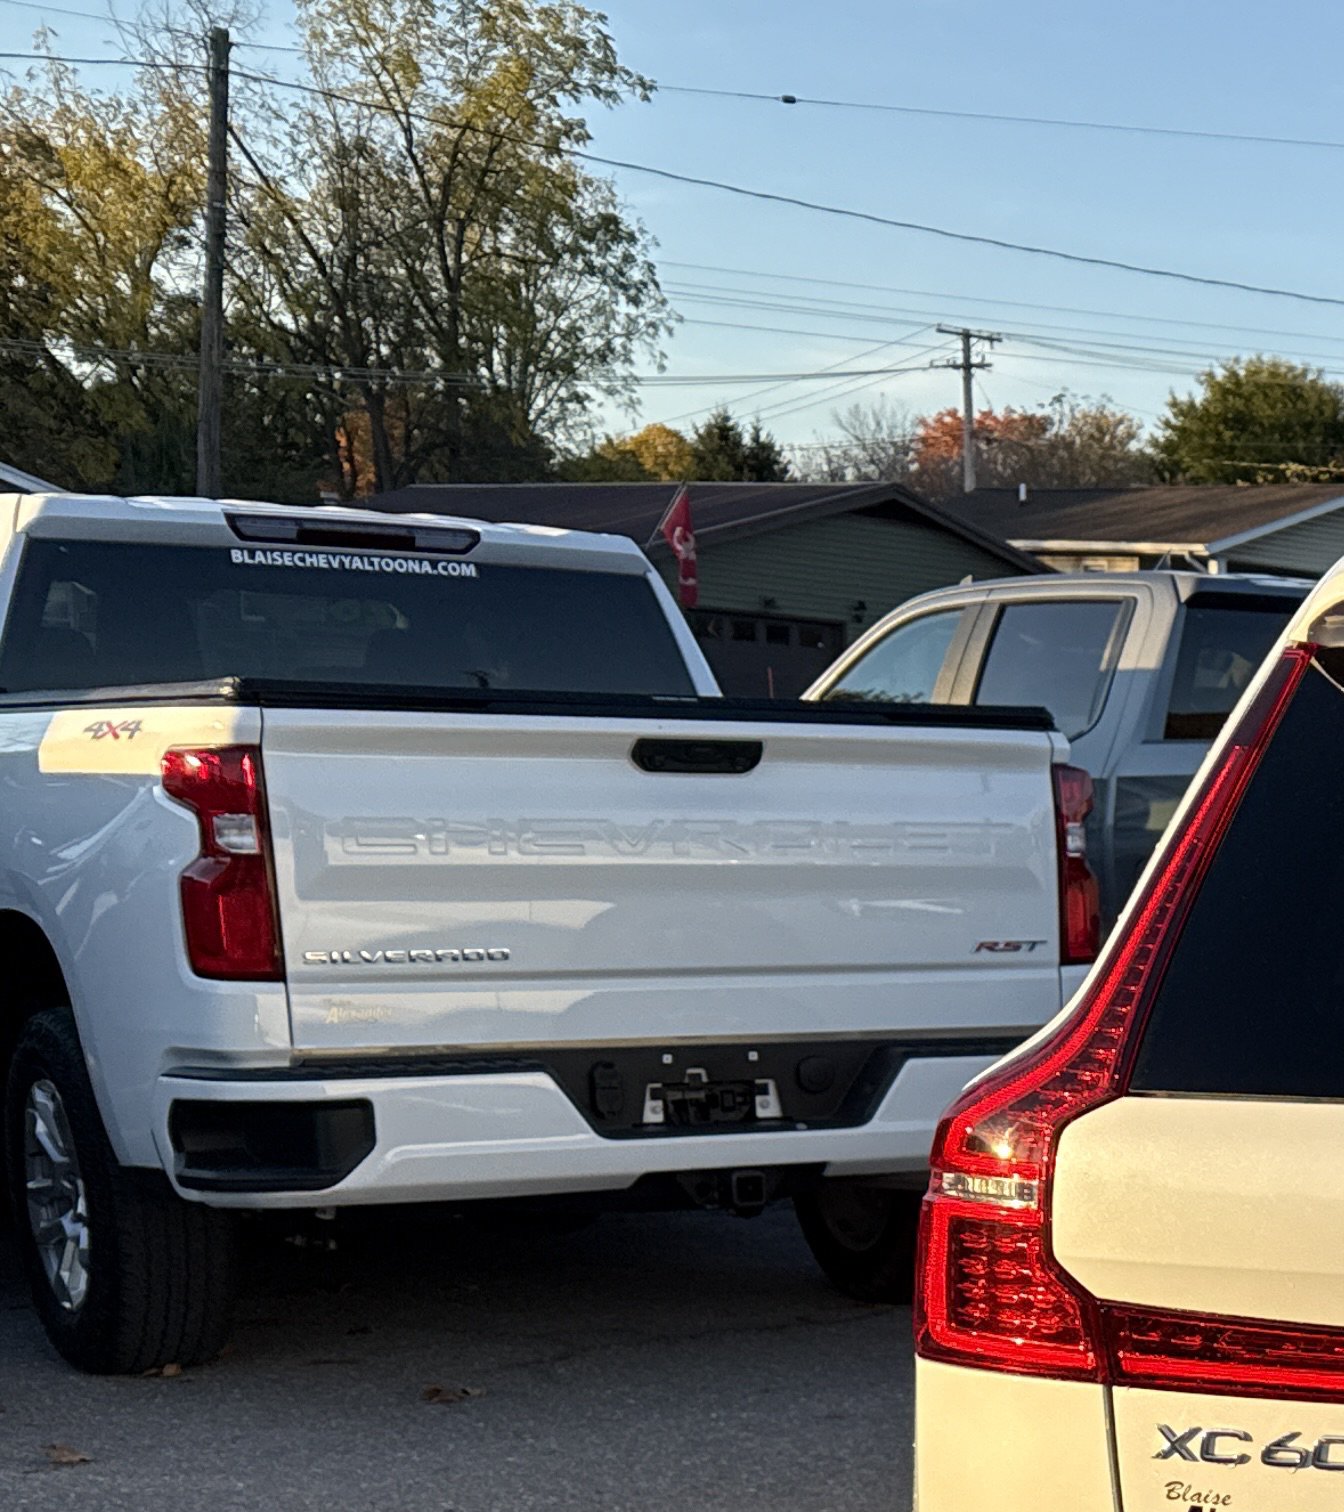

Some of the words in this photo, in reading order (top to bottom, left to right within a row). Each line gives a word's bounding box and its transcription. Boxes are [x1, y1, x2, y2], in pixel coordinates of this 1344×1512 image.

[230, 549, 478, 578] BLAISECHEVYALTOONA.COM
[303, 948, 510, 964] SILVERADO
[973, 940, 1047, 953] RST
[1164, 1480, 1233, 1506] Blaise
